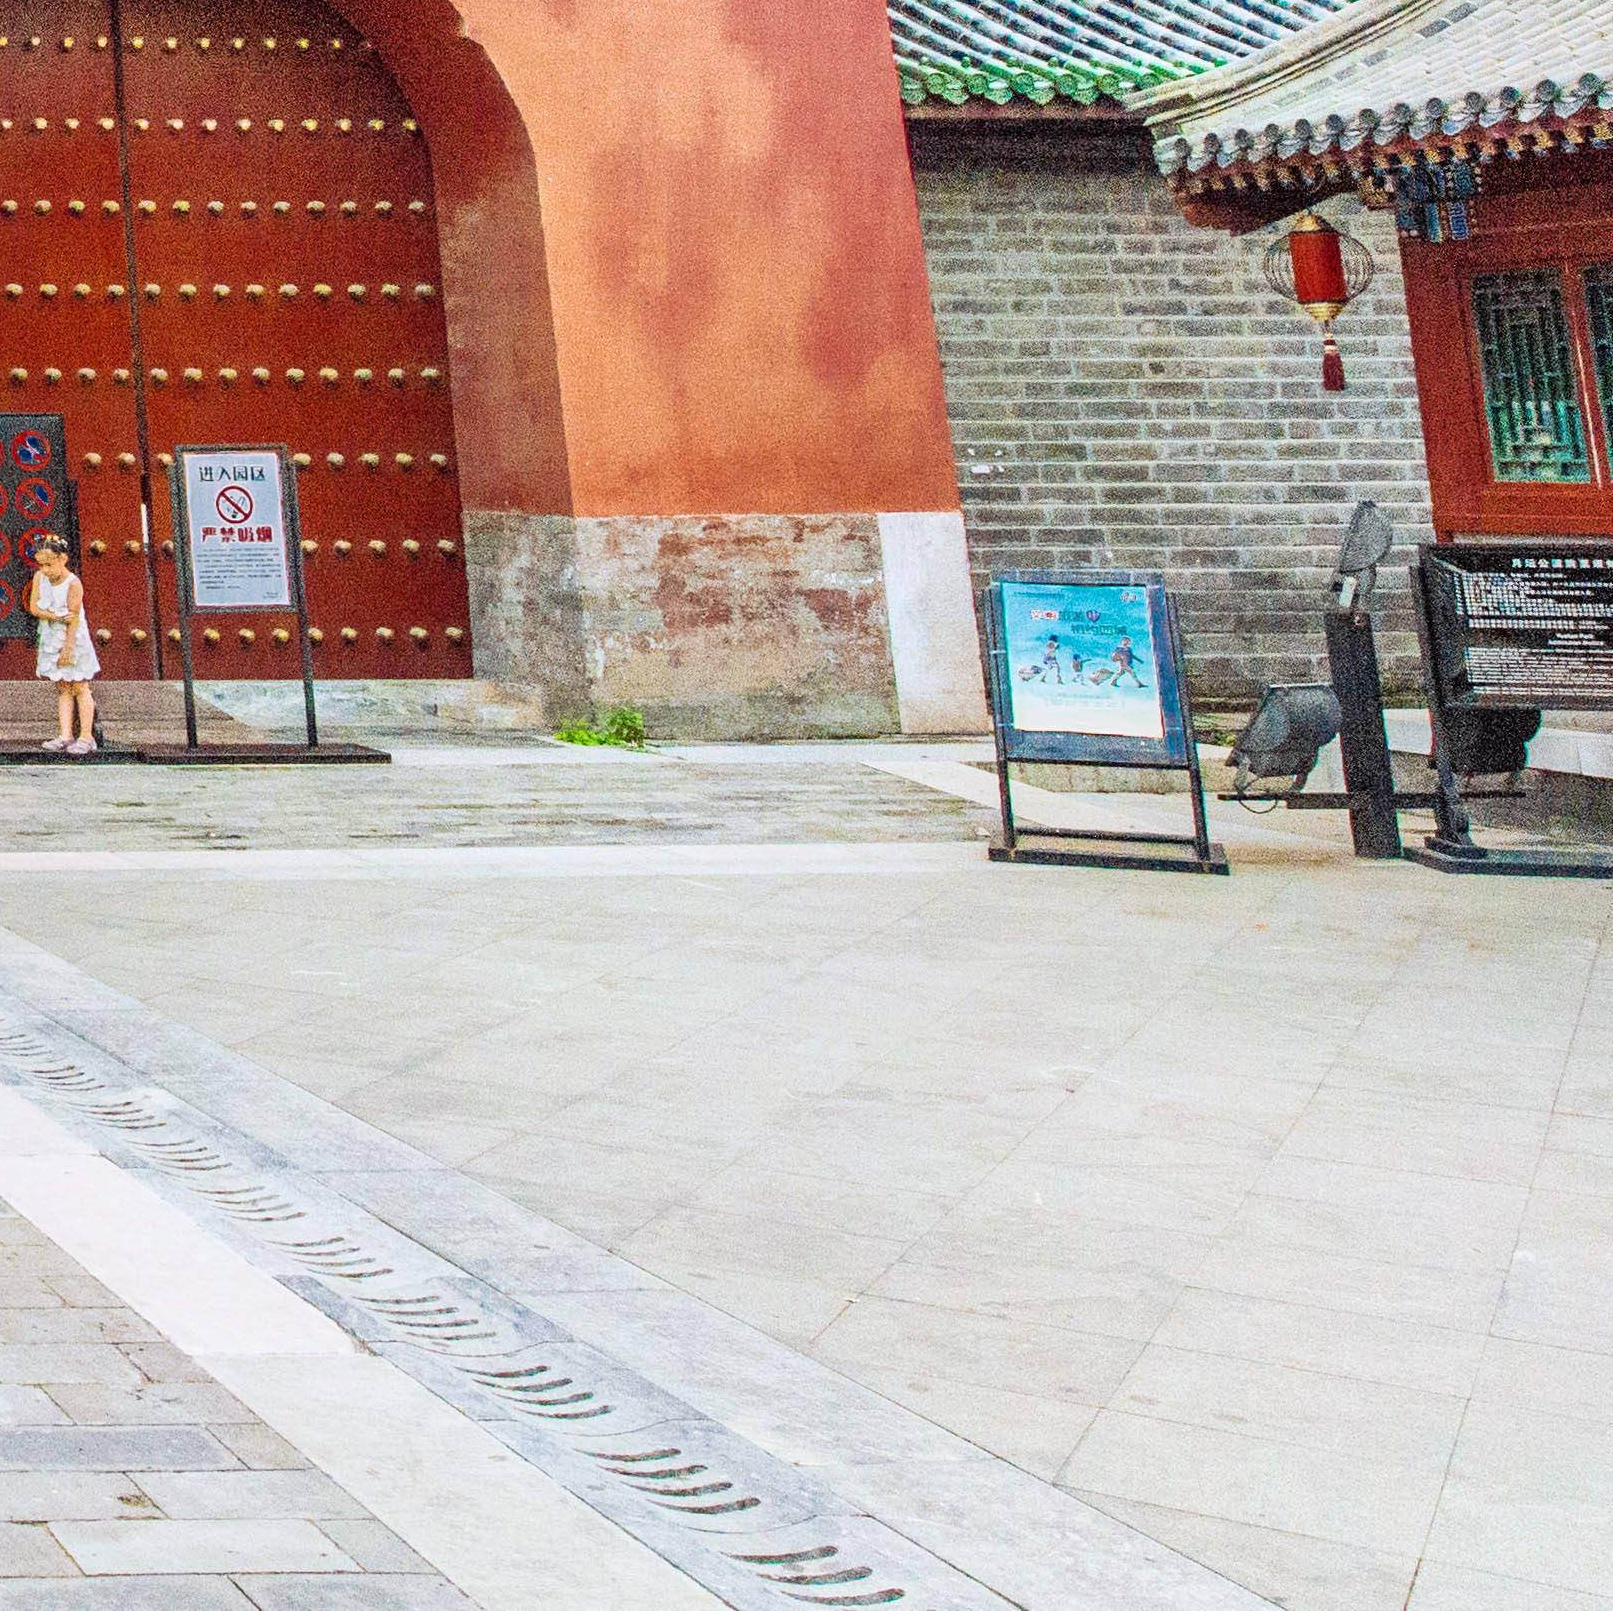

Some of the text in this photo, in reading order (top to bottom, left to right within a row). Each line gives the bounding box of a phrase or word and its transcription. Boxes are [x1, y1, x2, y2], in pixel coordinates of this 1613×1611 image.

[199, 466, 266, 482] 进入园区
[202, 526, 273, 543] 严禁吸烟
